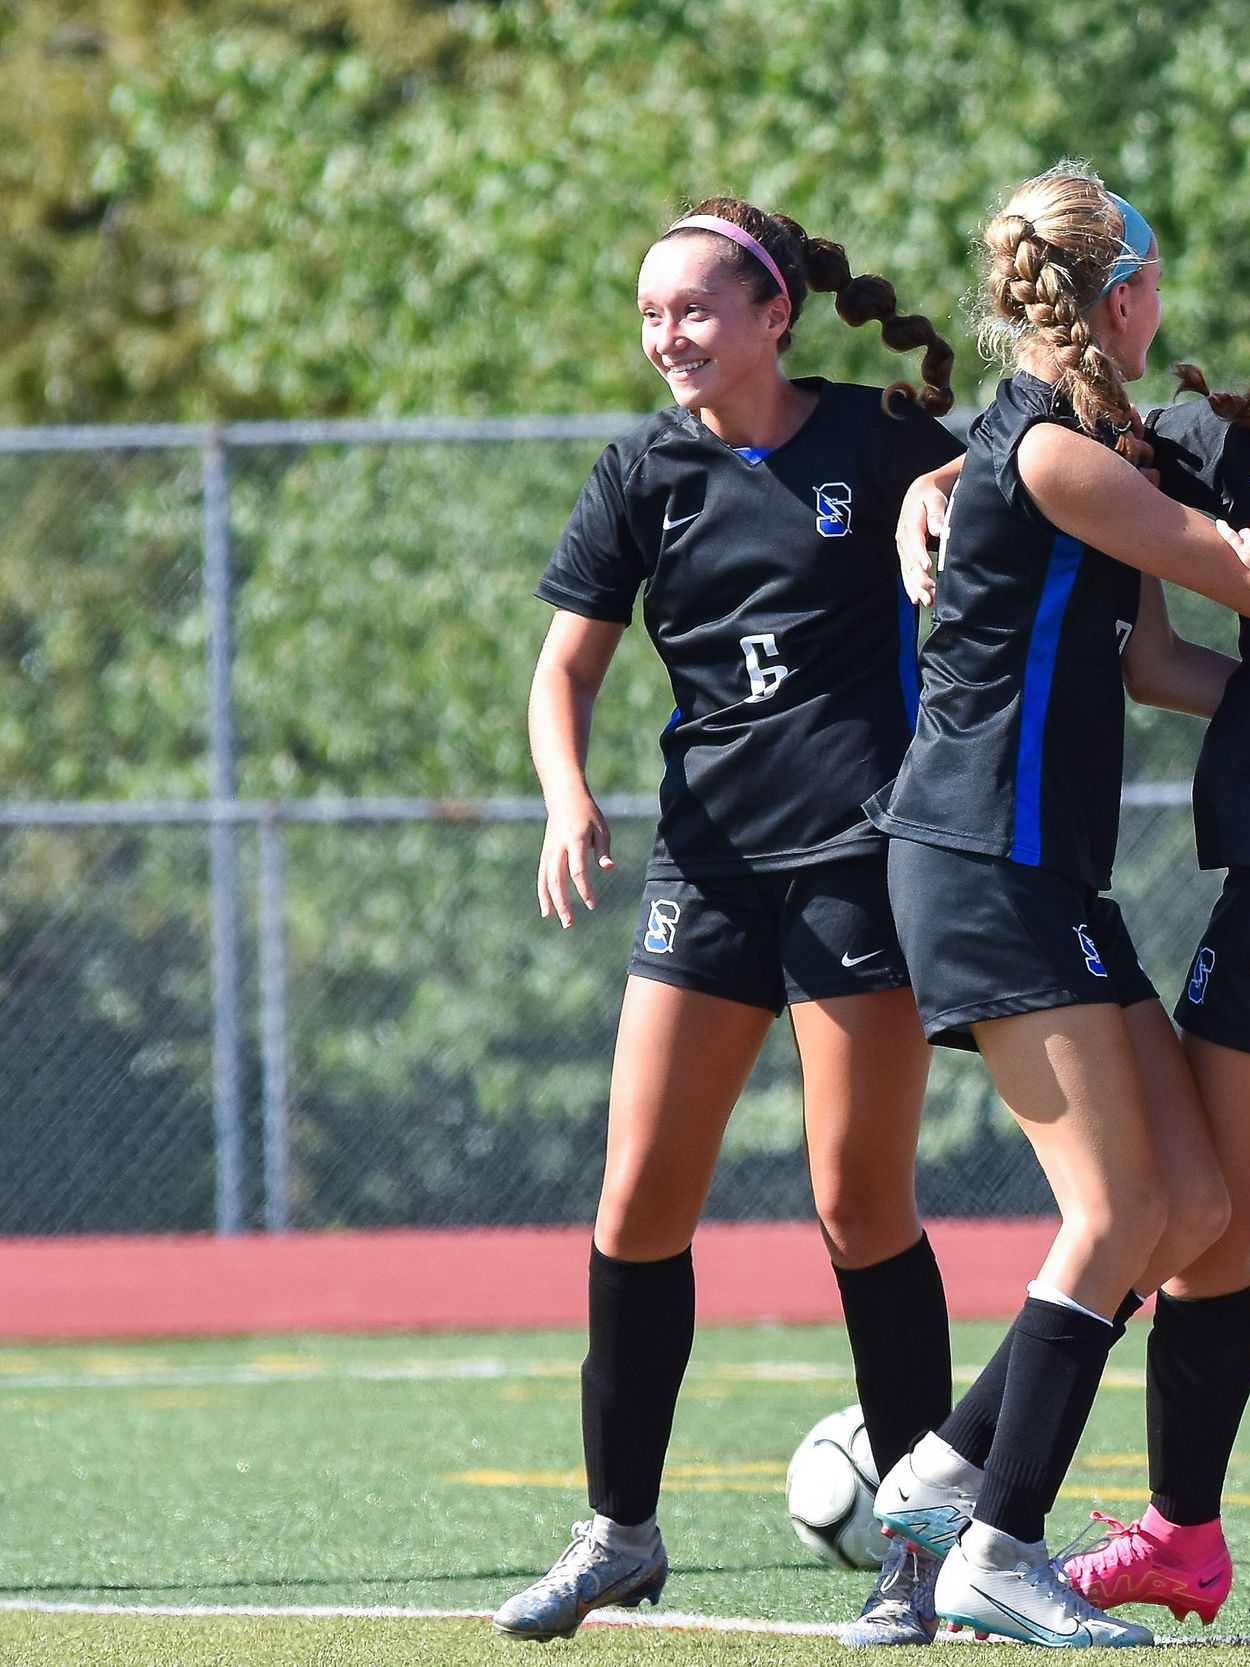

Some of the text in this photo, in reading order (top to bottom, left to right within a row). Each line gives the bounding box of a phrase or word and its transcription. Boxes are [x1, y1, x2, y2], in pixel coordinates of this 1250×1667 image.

[812, 482, 852, 537] S
[740, 633, 788, 704] 6
[643, 898, 681, 954] S
[1188, 946, 1215, 1005] S
